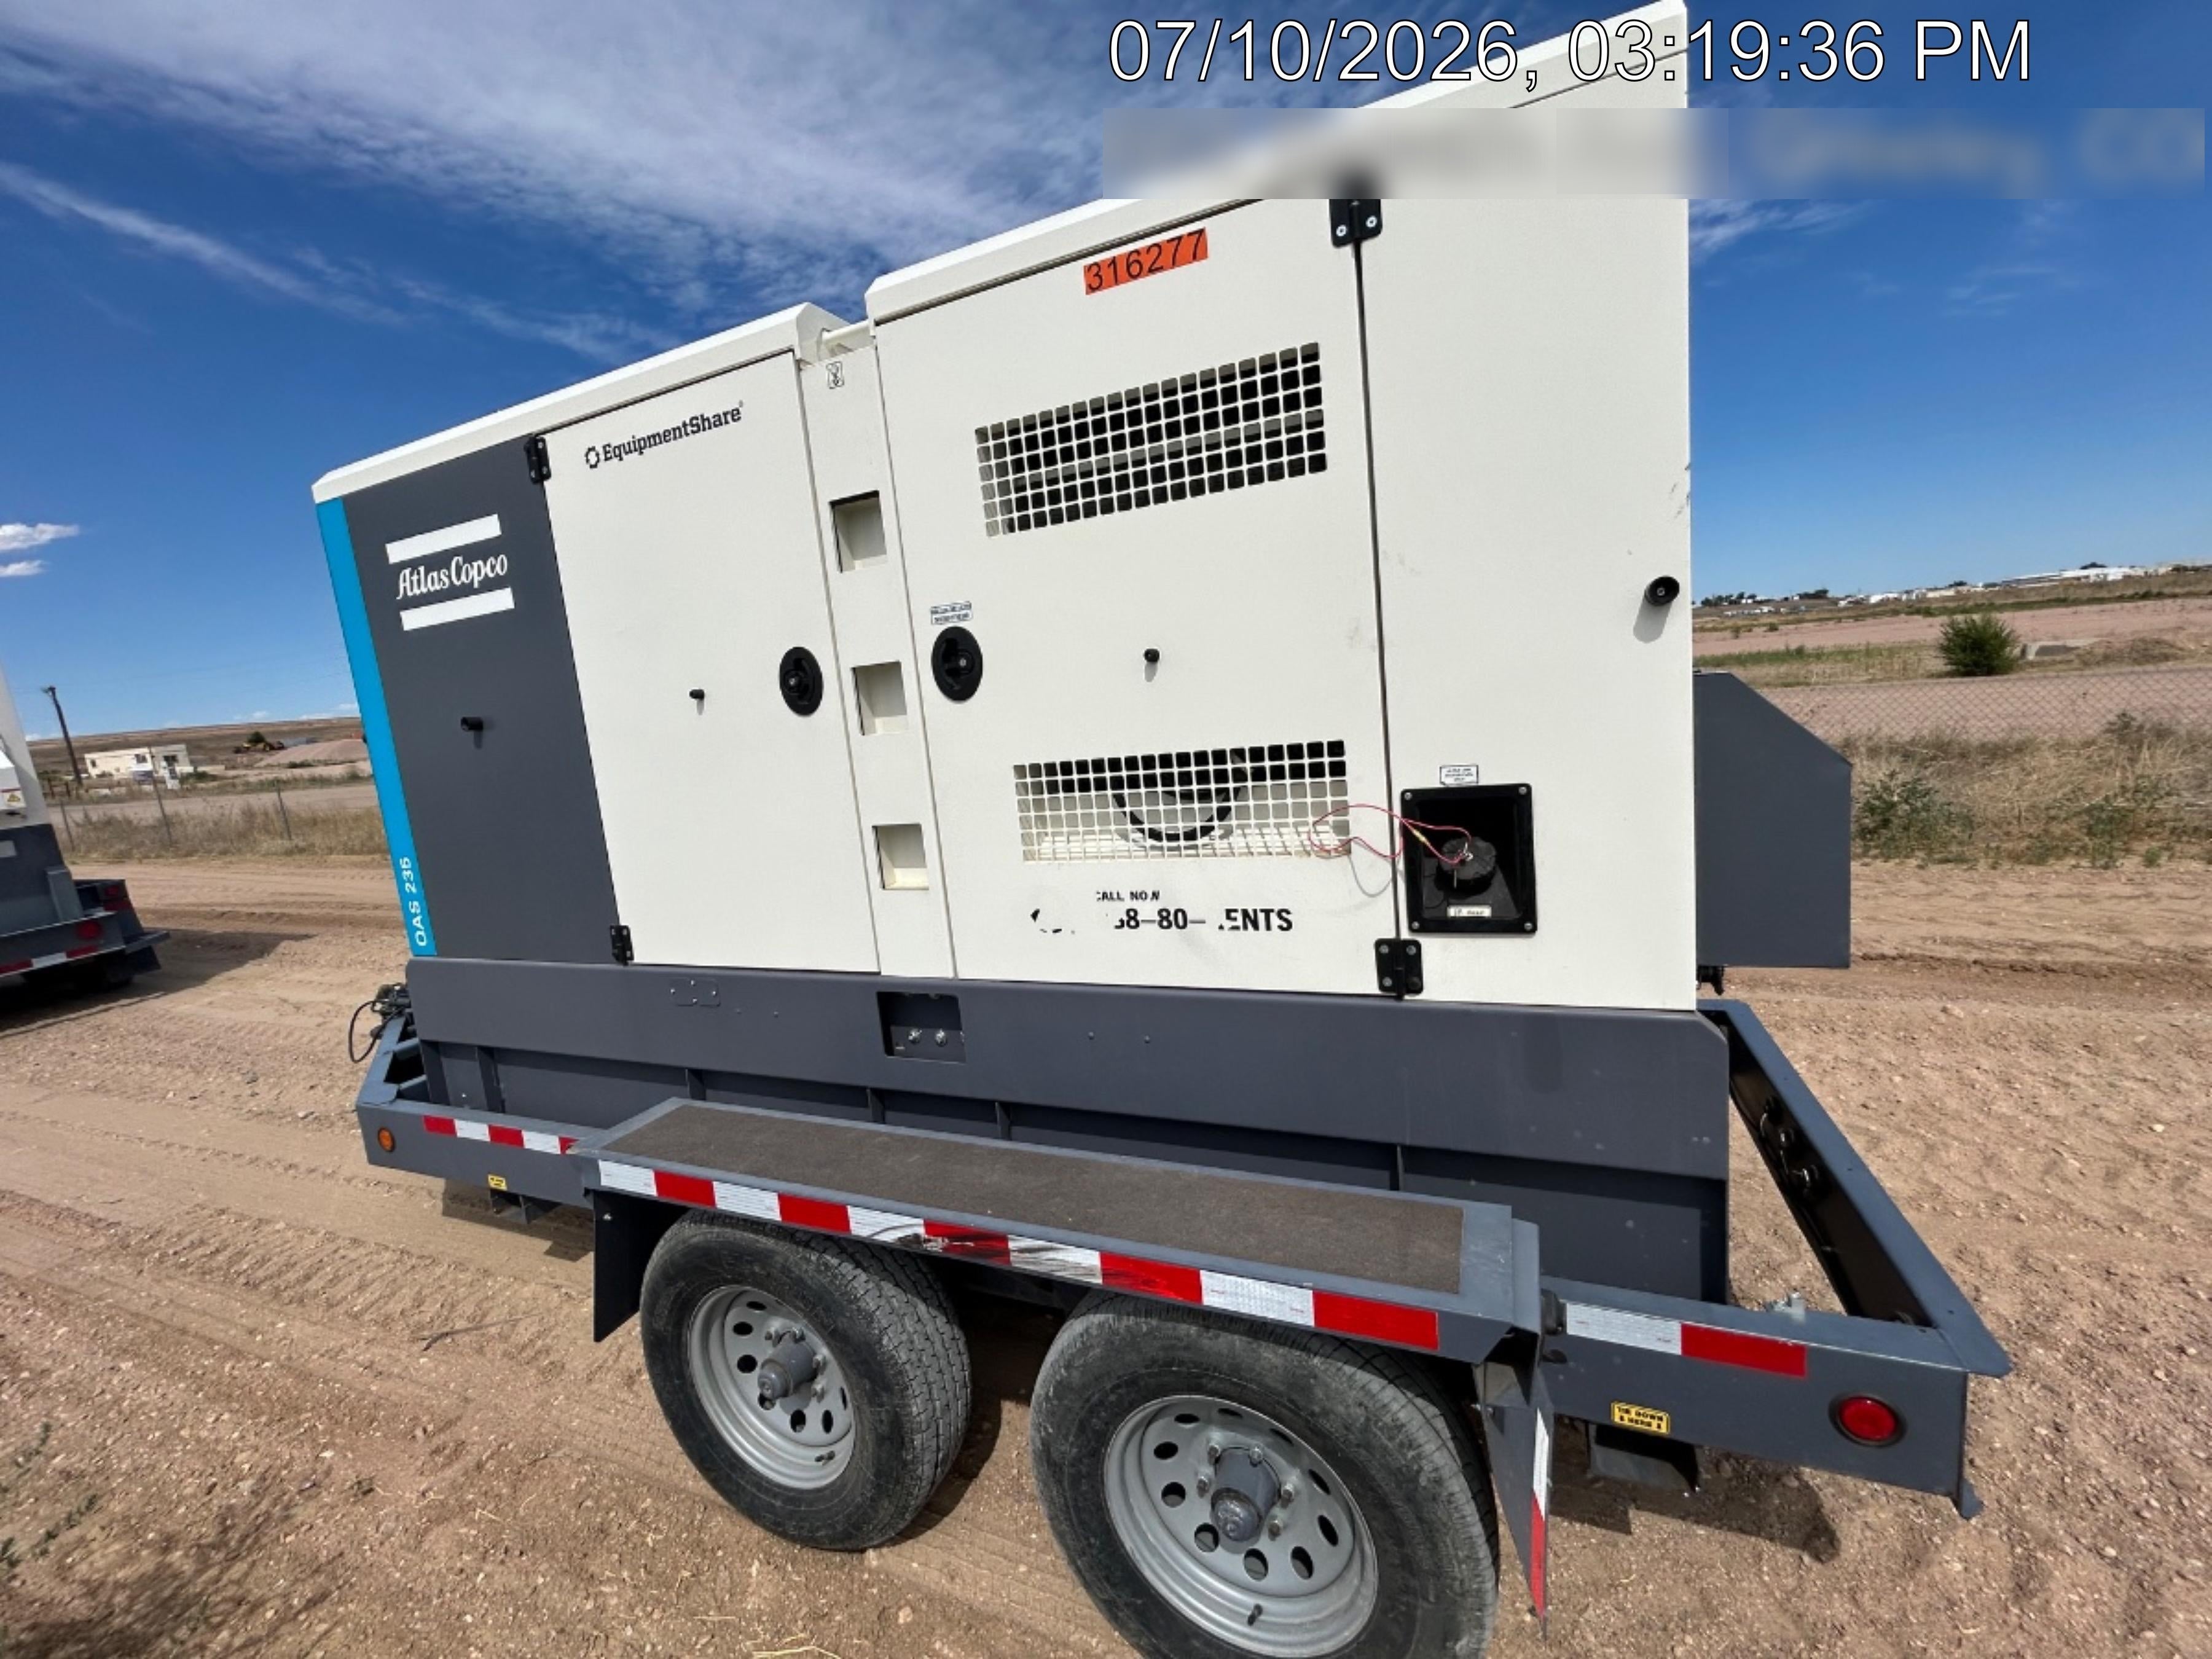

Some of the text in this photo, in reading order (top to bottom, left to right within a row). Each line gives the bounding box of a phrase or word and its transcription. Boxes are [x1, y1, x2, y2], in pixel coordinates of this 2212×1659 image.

[1087, 228, 1206, 291] 316277
[602, 407, 742, 461] EquipmentShare
[396, 554, 508, 600] Atlas Copco
